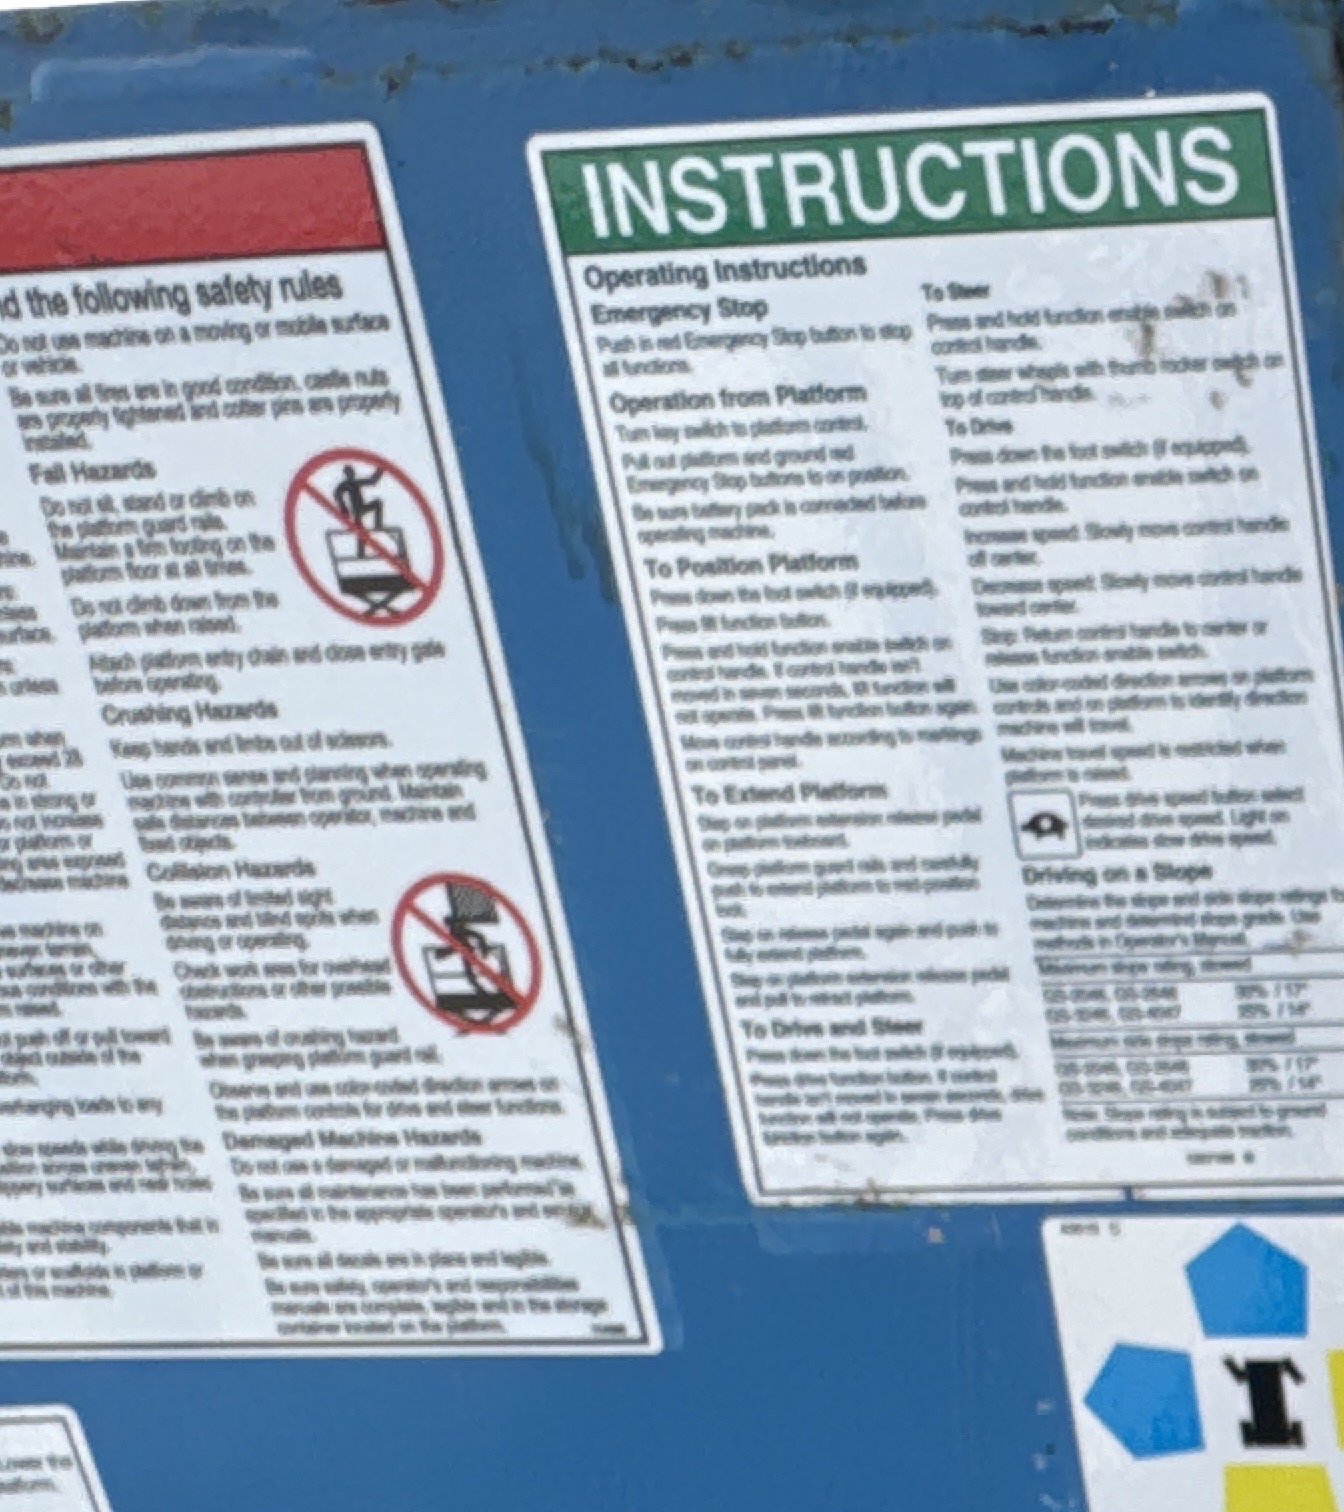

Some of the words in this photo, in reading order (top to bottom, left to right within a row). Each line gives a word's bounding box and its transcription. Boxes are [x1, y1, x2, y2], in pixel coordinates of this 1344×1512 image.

[582, 126, 1239, 239] INSTRUCTIONS
[584, 264, 709, 292] Operating
[714, 256, 867, 282] Instructions
[24, 287, 69, 318] the
[72, 281, 191, 315] following
[195, 274, 272, 310] safety
[279, 270, 344, 302] rules
[921, 284, 944, 302] To
[947, 282, 990, 300] Steer
[590, 304, 711, 326] Emergency
[716, 297, 769, 321] Stop
[609, 392, 715, 415] Operation
[718, 389, 770, 408] from
[775, 384, 868, 405] Platform
[944, 418, 968, 436] To
[970, 417, 1014, 435] Drive
[28, 463, 66, 485] Fall
[70, 461, 156, 482] Hazards
[643, 558, 672, 578] To
[676, 557, 764, 577] Position
[768, 553, 859, 573] Platform
[101, 704, 193, 726] Crushing
[195, 701, 278, 721] Hazards
[691, 785, 720, 805] To
[723, 784, 795, 804] Extend
[799, 782, 888, 801] Platform
[146, 862, 231, 882] Collision
[234, 860, 316, 878] Hazards
[1022, 866, 1098, 886] Driving
[1102, 867, 1130, 883] on
[1134, 867, 1148, 882] a
[1152, 862, 1213, 883] Slope
[741, 1020, 768, 1039] To
[771, 1020, 824, 1038] Drive
[829, 1019, 866, 1036] and
[871, 1017, 923, 1036] Steer
[222, 1132, 315, 1152] Damaged
[318, 1130, 400, 1148] Machine
[403, 1129, 482, 1146] Hazards
